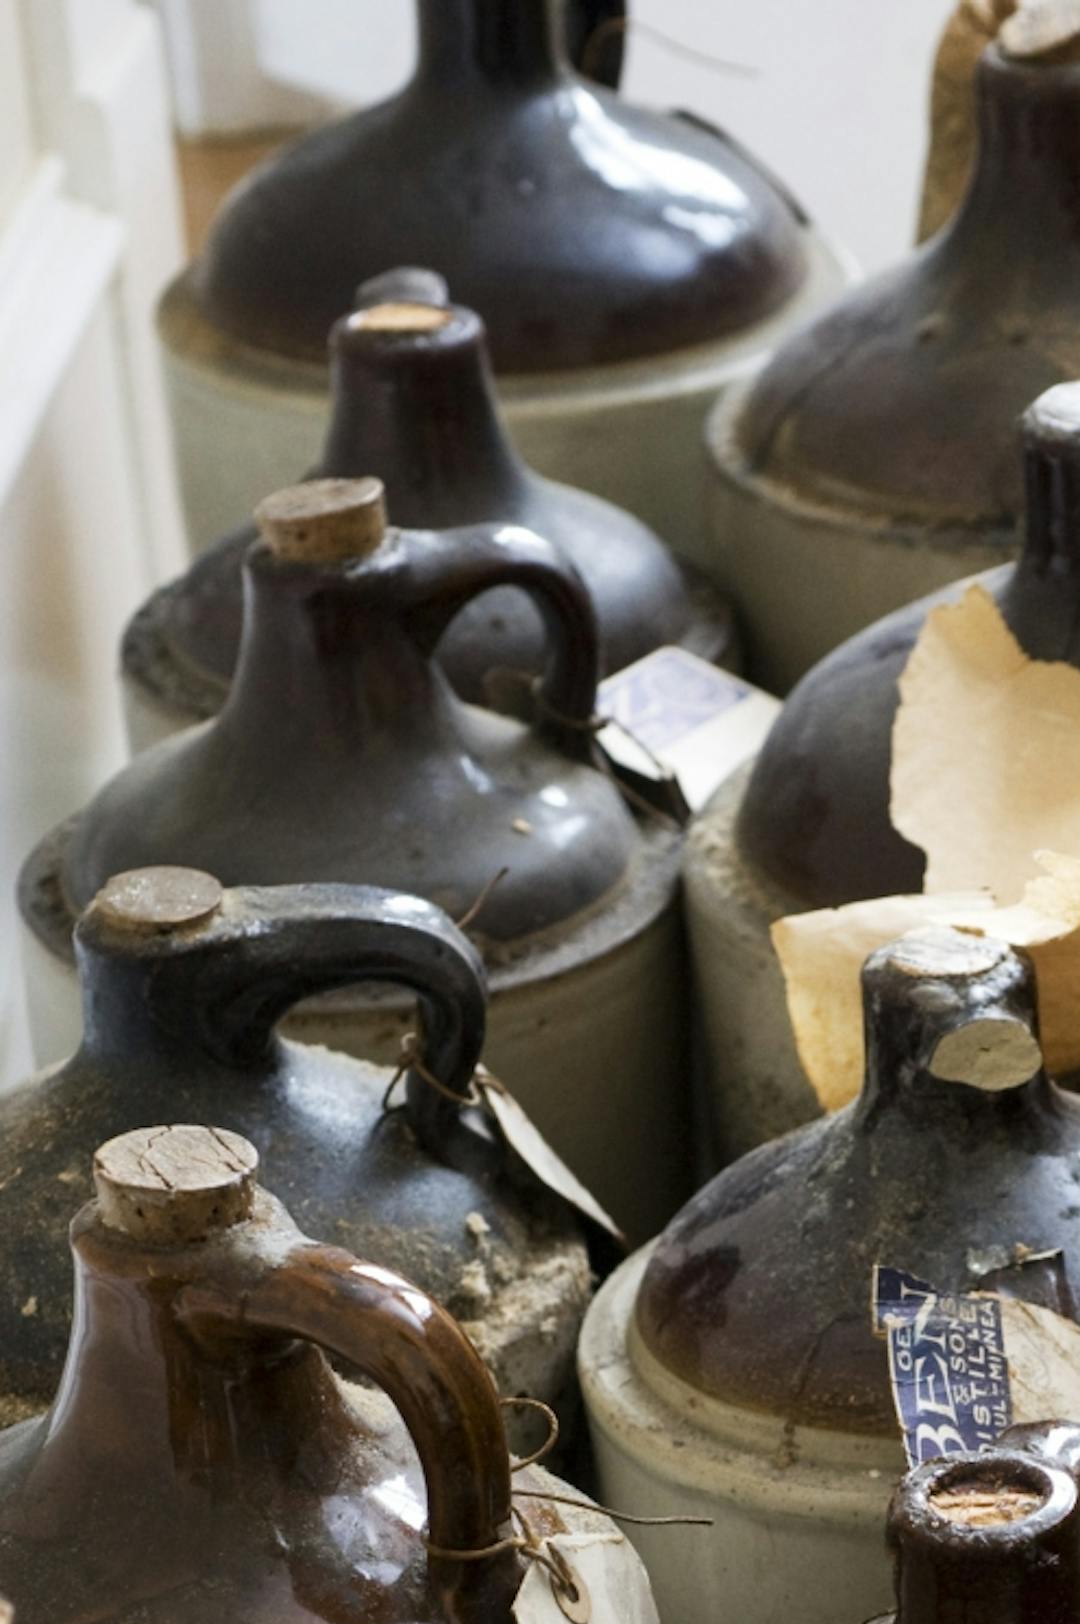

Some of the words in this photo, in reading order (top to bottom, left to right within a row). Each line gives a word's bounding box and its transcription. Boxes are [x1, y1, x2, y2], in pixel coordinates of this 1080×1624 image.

[901, 1282, 968, 1468] BEN
[953, 1383, 971, 1405] &
[960, 1302, 993, 1456] DISTILLE
